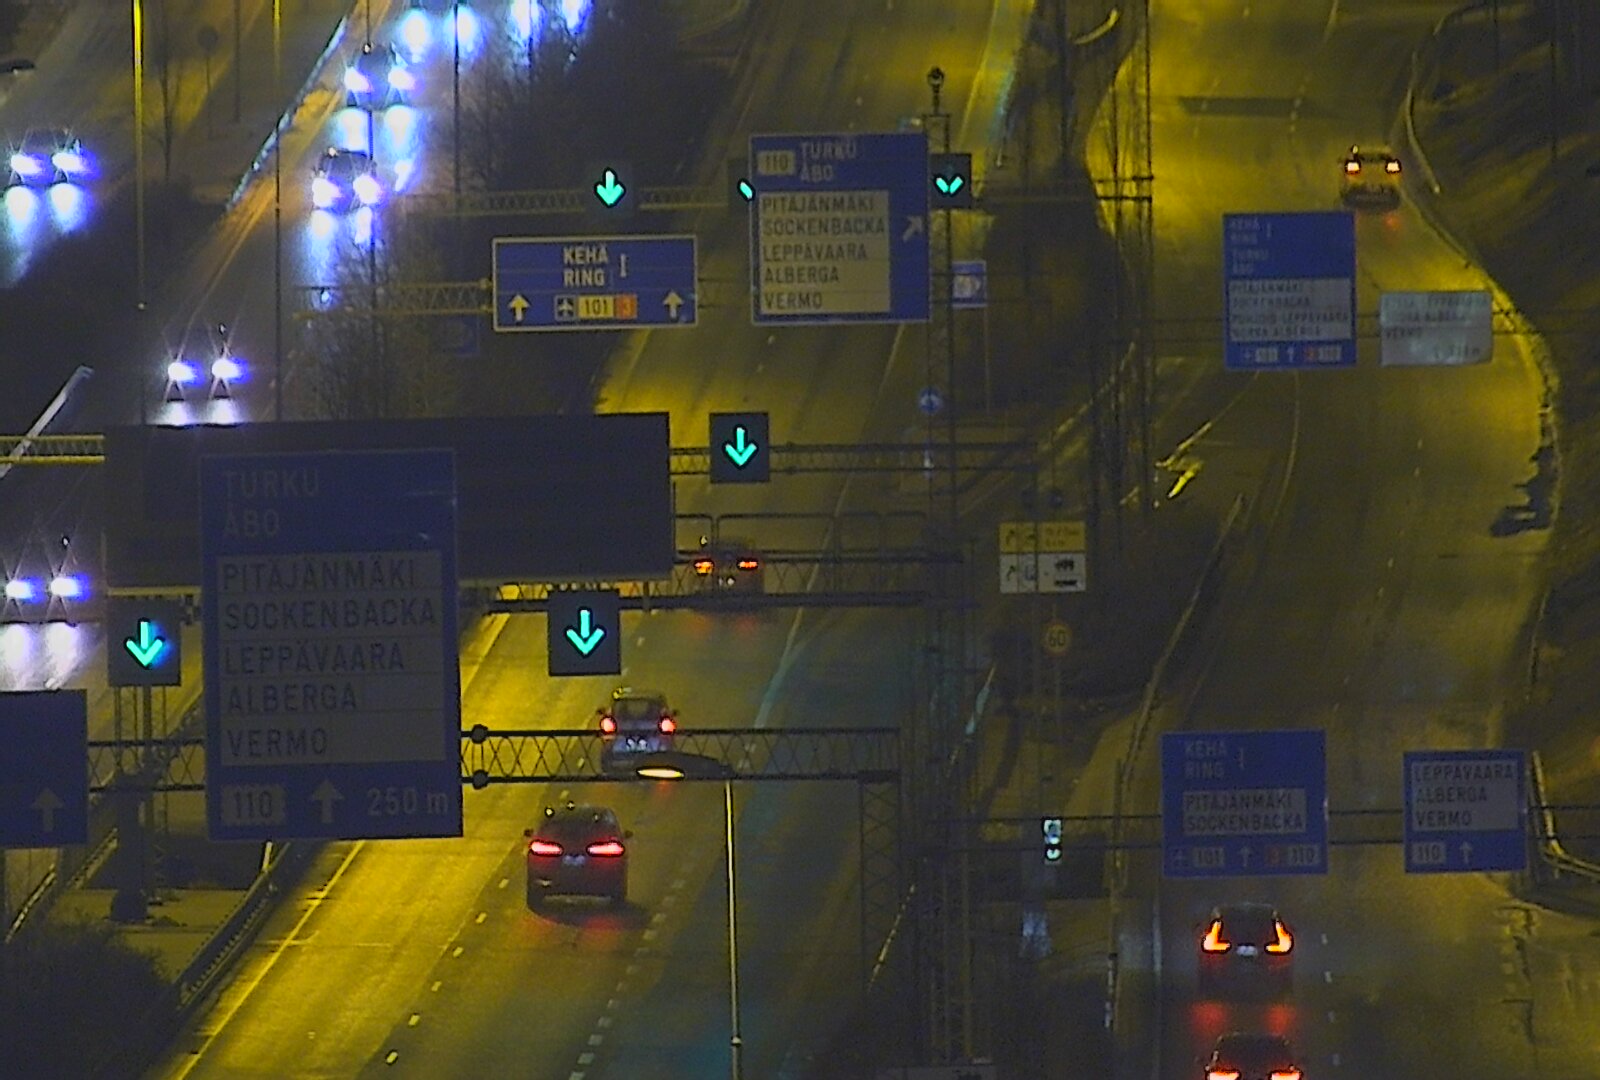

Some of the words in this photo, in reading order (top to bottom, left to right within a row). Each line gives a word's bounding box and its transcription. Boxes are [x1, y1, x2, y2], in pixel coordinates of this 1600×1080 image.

[801, 141, 857, 160] TURKU
[765, 155, 789, 171] 110
[763, 217, 885, 236] SOCKENBACKA
[563, 242, 609, 265] KEHÄ
[619, 253, 627, 278] I
[563, 269, 605, 287] RING
[764, 266, 840, 284] ALBERGA
[585, 299, 608, 315] 101
[764, 292, 823, 310] VERMO
[222, 468, 319, 498] TURKU
[223, 502, 280, 539] ÅBO
[222, 554, 416, 592] PITÄJÄNMÄKI
[224, 598, 436, 630] SOCKENBACKA
[224, 641, 405, 675] LEPPÄVAARA
[228, 683, 358, 715] ALBERGA
[227, 727, 329, 758] VERMO
[1184, 760, 1225, 779] RING
[233, 790, 274, 819] 110
[367, 787, 418, 817] 250
[426, 791, 449, 815] m
[1416, 786, 1488, 804] ALBERGA
[1186, 813, 1303, 832] SOCKENBACKA
[1415, 810, 1472, 828] VERMO
[1197, 848, 1221, 864] 101
[1418, 844, 1441, 862] 110
